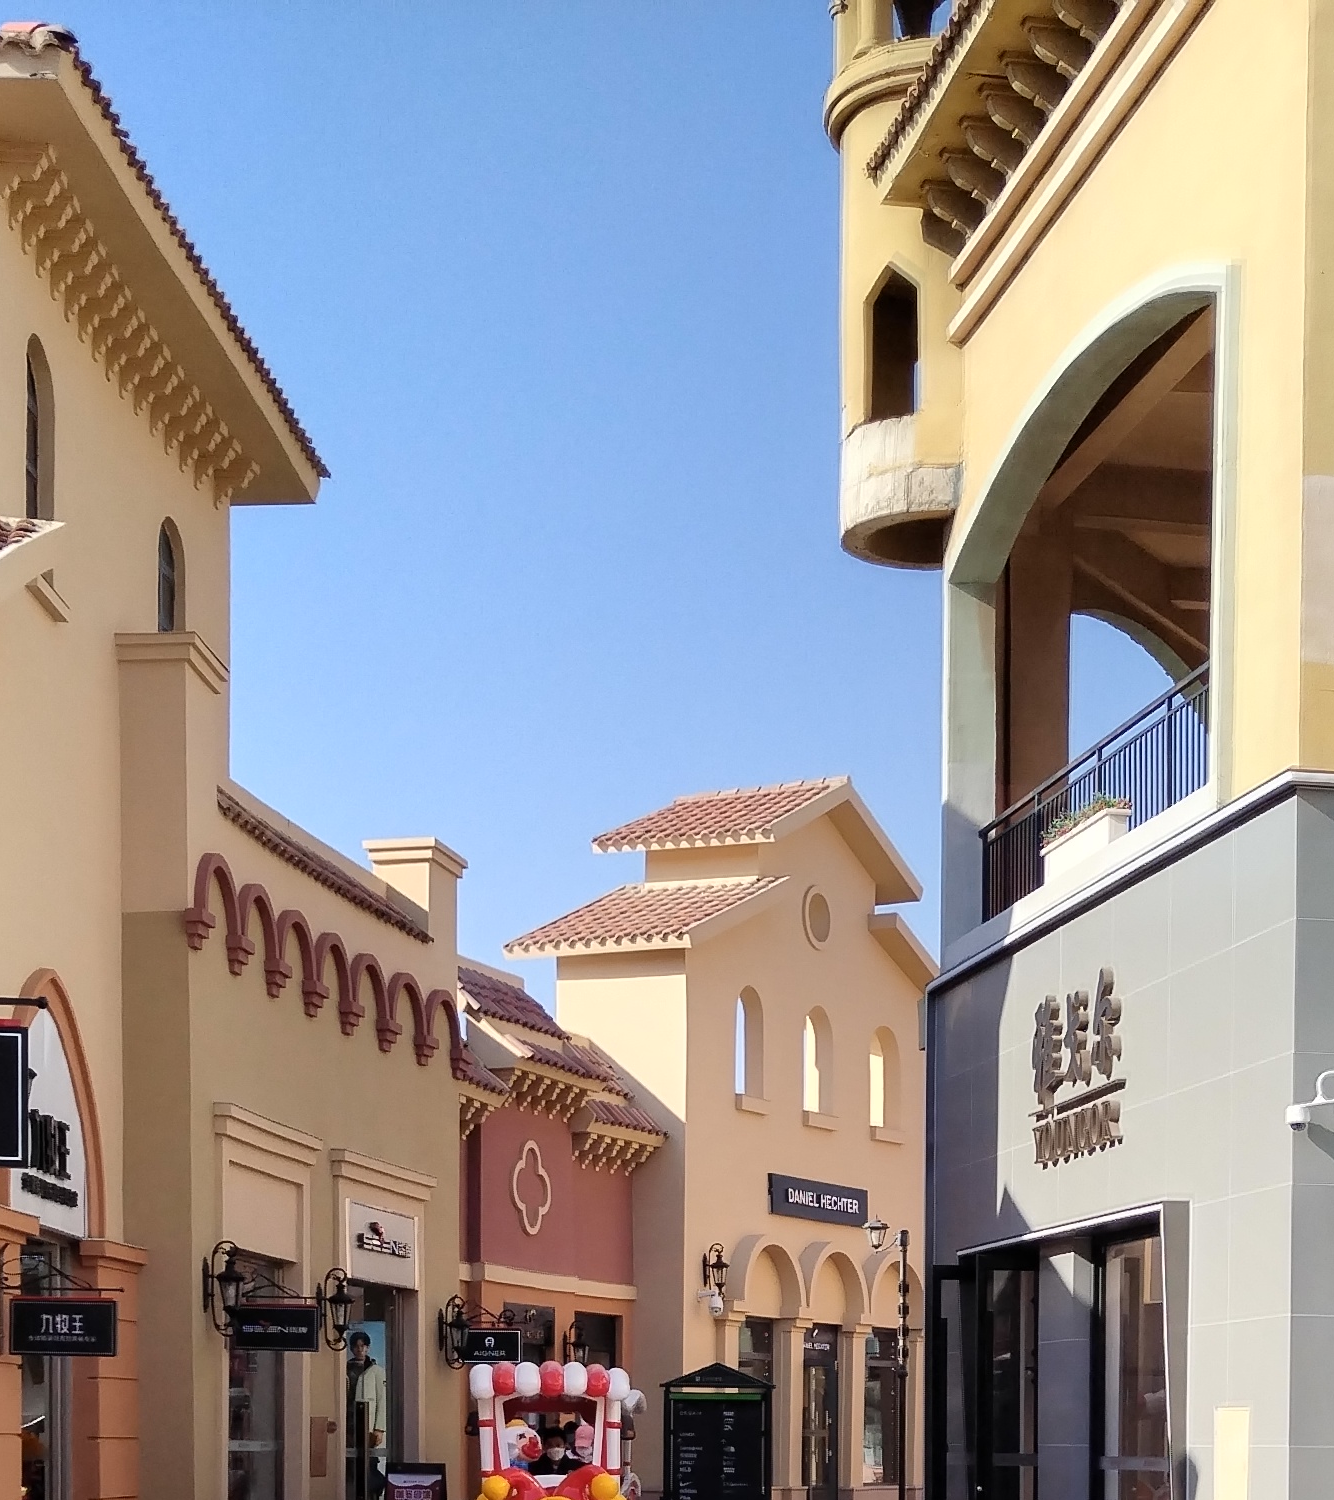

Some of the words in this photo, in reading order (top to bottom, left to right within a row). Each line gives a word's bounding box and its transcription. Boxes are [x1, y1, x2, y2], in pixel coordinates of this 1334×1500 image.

[1032, 966, 1122, 1110] 雅戈尔
[1033, 1101, 1123, 1169] YOUNGOR
[788, 1187, 819, 1207] DANIEL
[820, 1194, 859, 1214] HECHTER
[40, 1314, 84, 1334] 九牧王
